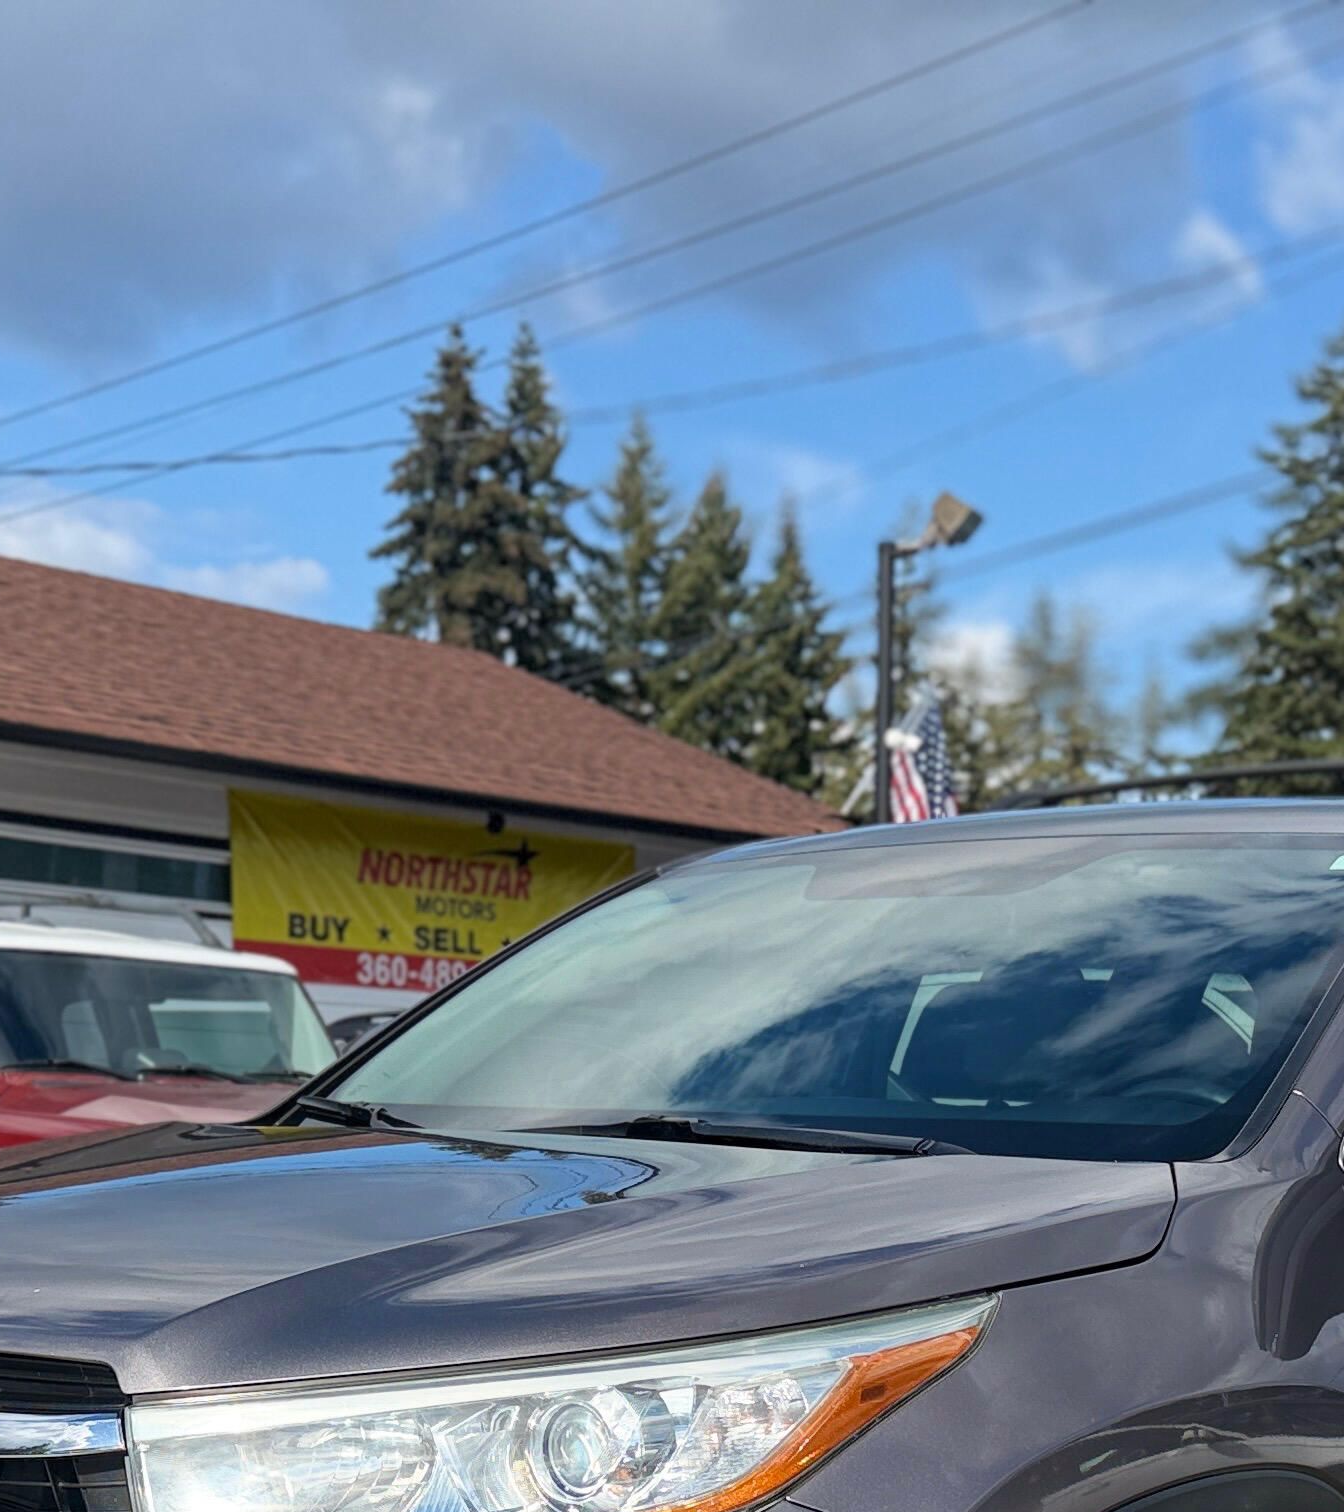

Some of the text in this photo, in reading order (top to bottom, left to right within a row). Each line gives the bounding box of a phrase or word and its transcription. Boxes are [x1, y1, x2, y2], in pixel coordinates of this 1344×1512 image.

[358, 847, 532, 901] NORTHSTAR
[415, 896, 497, 921] MOTORS
[287, 912, 482, 955] BUY SELL
